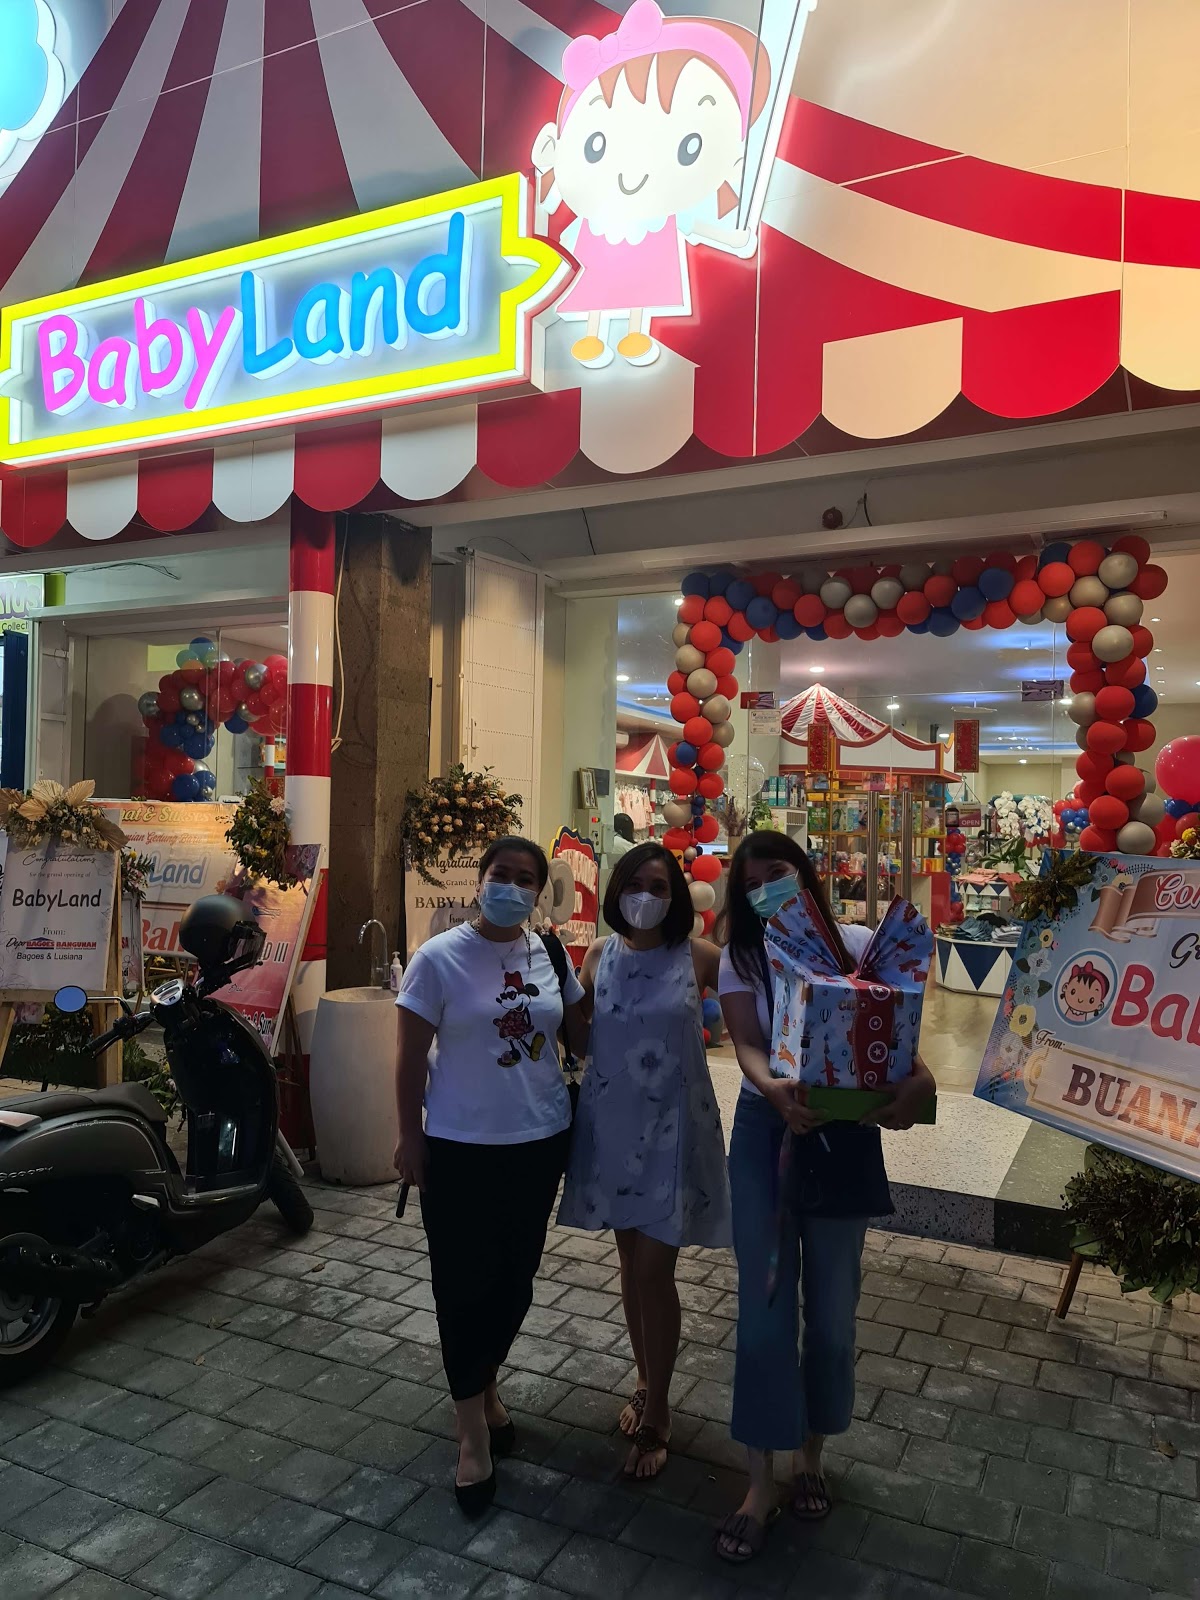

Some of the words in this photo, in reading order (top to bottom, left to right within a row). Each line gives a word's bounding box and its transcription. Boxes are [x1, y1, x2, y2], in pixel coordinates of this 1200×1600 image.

[37, 211, 469, 413] BabyLand
[143, 805, 156, 822] &
[158, 806, 210, 822] Sukses
[146, 832, 178, 845] Gedung
[12, 888, 102, 912] BabyLand
[415, 897, 456, 908] BABY
[461, 897, 479, 908] LA
[17, 952, 44, 961] Bagoes
[1036, 1030, 1065, 1050] From:
[1062, 1063, 1200, 1148] BUAN
